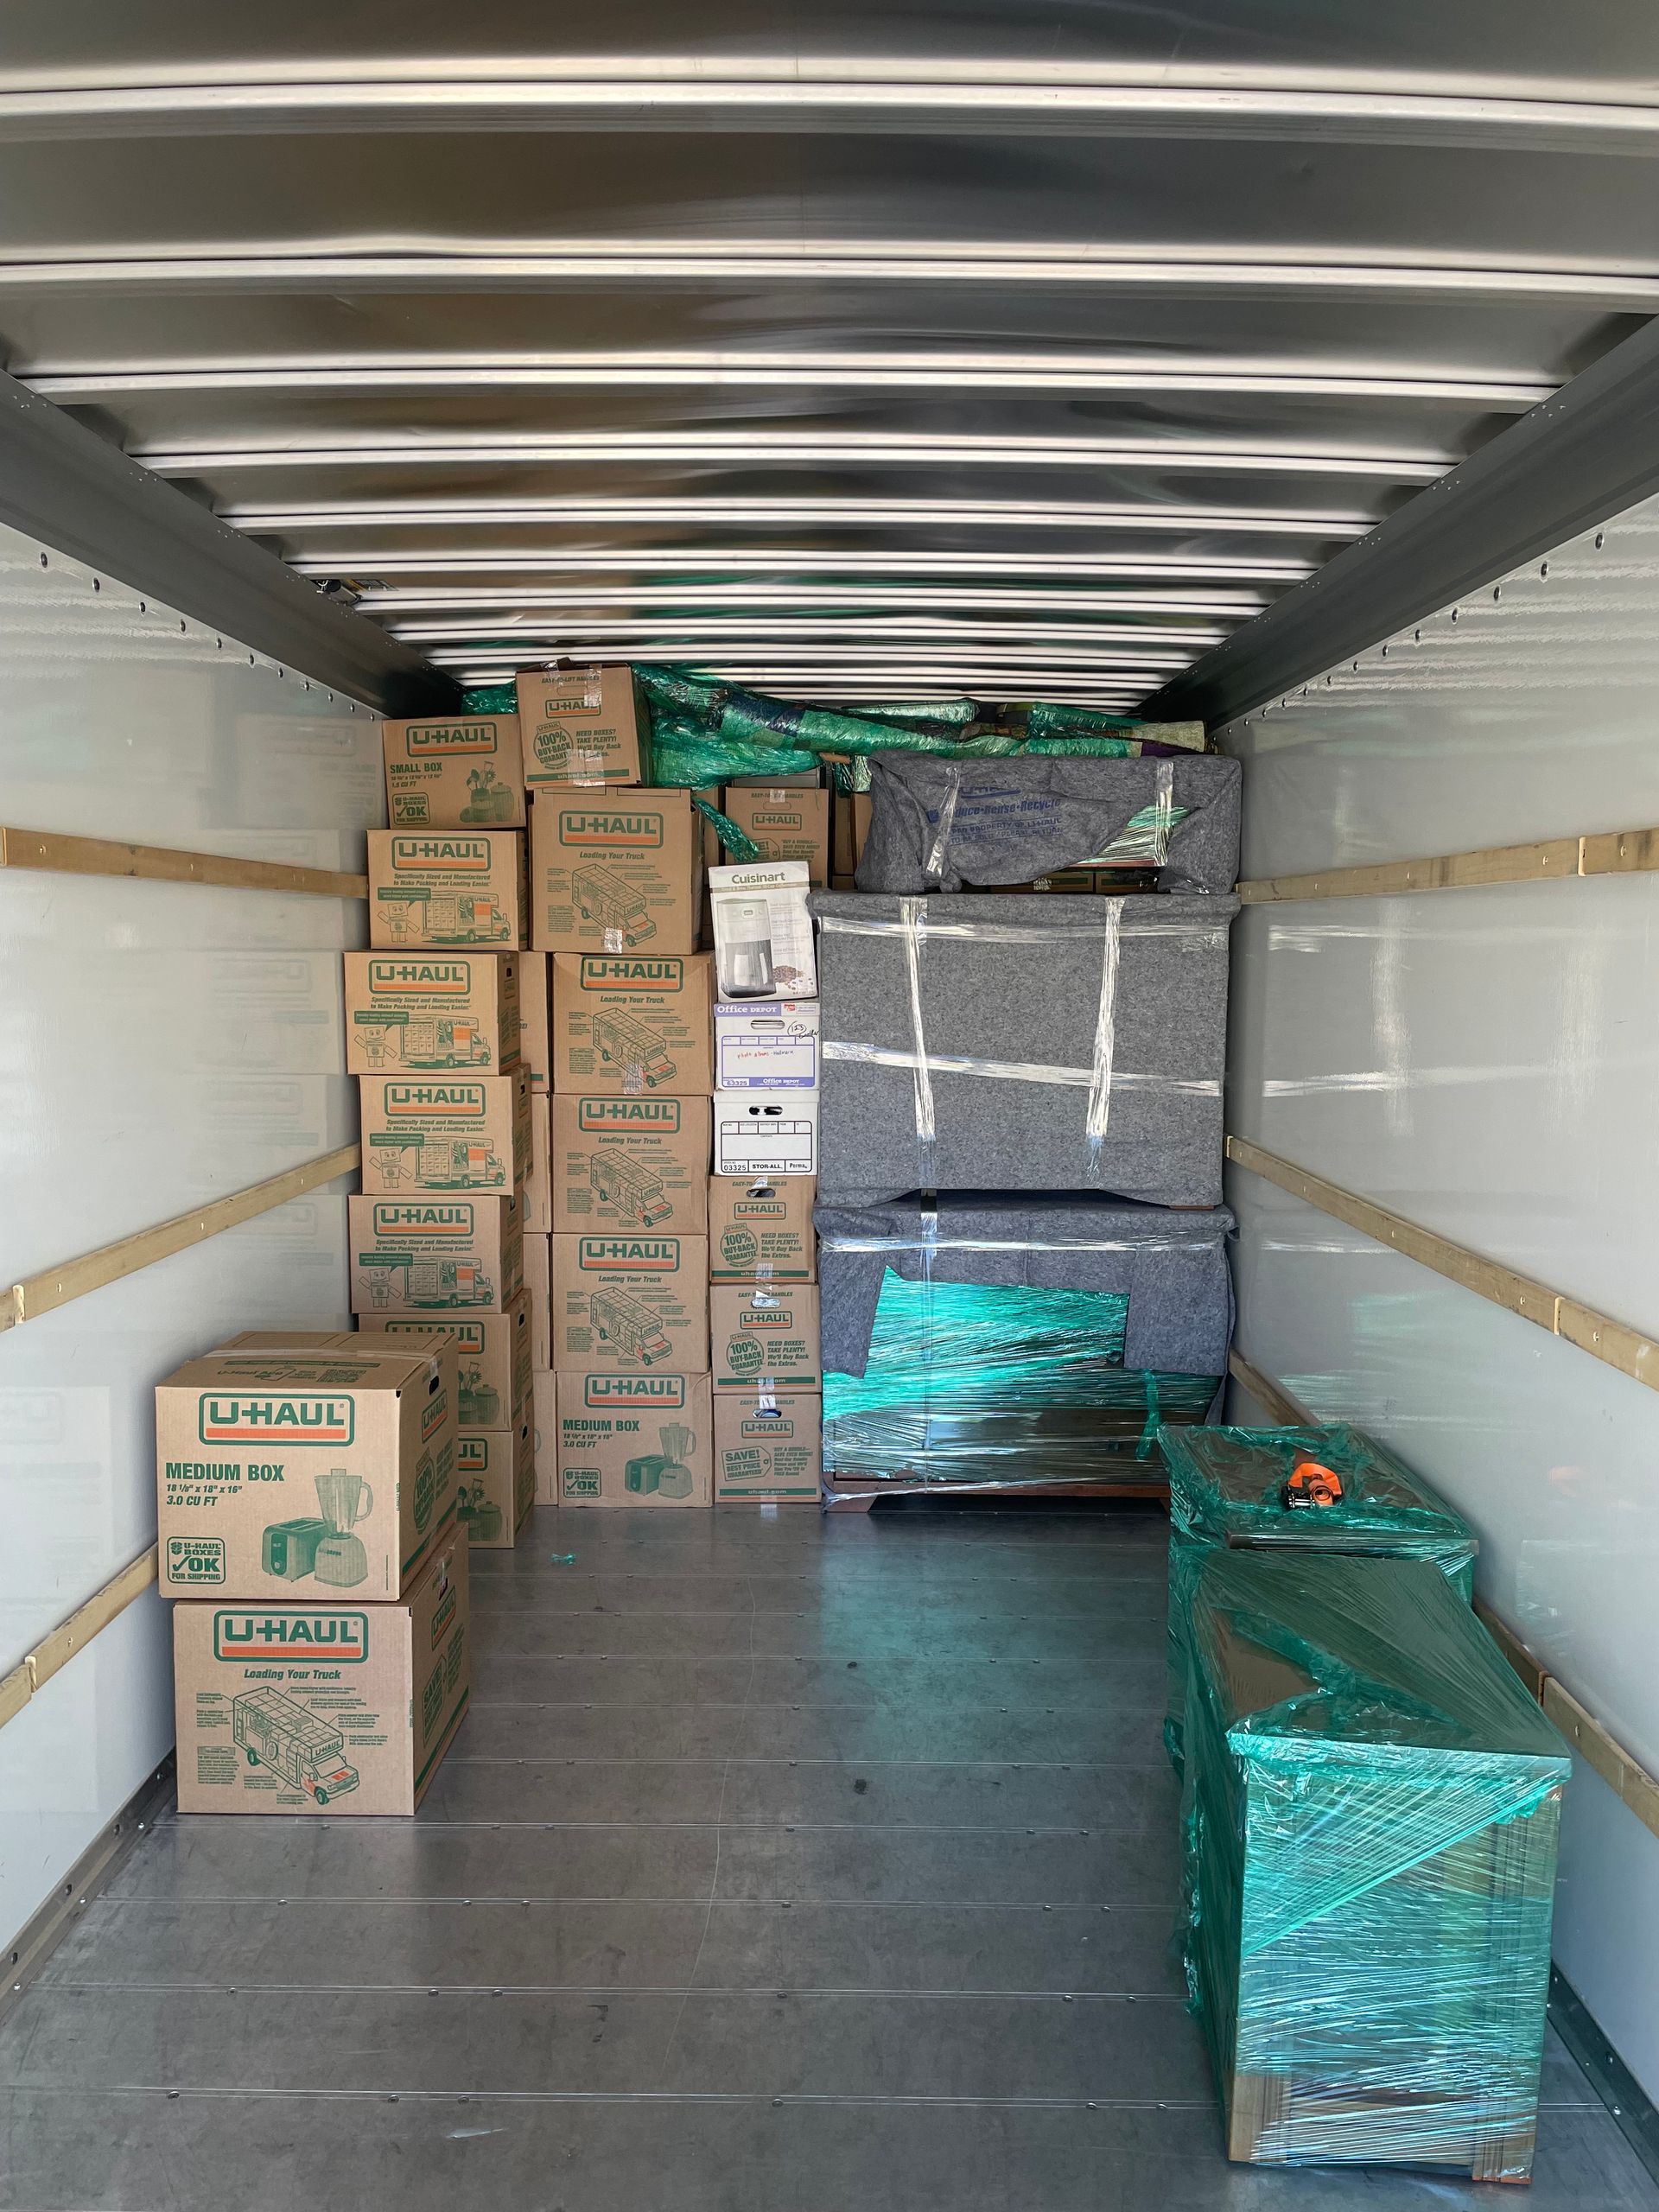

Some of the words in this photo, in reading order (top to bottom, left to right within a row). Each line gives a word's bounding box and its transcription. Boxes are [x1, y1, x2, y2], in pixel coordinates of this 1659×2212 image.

[412, 728, 492, 745] U-HAUL
[537, 731, 567, 747] 100%
[537, 742, 570, 757] BUY-BACK
[390, 763, 421, 774] SMALL
[423, 762, 442, 772] BOX
[405, 806, 427, 817] OK
[566, 817, 657, 835] U-HAUL
[755, 816, 799, 824] U-HAUL
[398, 842, 484, 858] U-HAUL
[579, 851, 607, 860] Loading
[731, 872, 785, 885] Cuisinart
[376, 965, 464, 982] U-HAUL
[588, 962, 677, 979] U-HAUL
[600, 995, 627, 1004] Loading
[716, 1005, 748, 1014] Office
[391, 1088, 479, 1103] U-HAUL
[586, 1103, 674, 1120] U-HAUL
[737, 1205, 783, 1213] U-HAUL
[380, 1209, 467, 1224] U-HAUL
[724, 1232, 752, 1246] 100%
[586, 1243, 673, 1259] U-HAUL
[723, 1243, 755, 1255] BUY-BACK
[743, 1313, 789, 1323] U-HAUL
[730, 1340, 759, 1355] 100%
[729, 1351, 762, 1363] BUY-BACK
[592, 1380, 678, 1395] U-HAUL
[209, 1402, 345, 1426] U-HAUL
[563, 1419, 612, 1432] MEDIUM
[615, 1420, 640, 1432] BOX
[745, 1423, 791, 1432] U-HAUL
[725, 1449, 760, 1462] SAVE!
[165, 1462, 241, 1481] MEDIUM
[247, 1464, 285, 1482] BOX
[576, 1481, 598, 1491] OK
[167, 1495, 183, 1505] 3.0
[187, 1496, 201, 1505] CU
[203, 1497, 218, 1507] FT
[188, 1557, 221, 1573] OK
[225, 1619, 359, 1643] U-HAUL
[244, 1668, 284, 1681] Loading
[287, 1669, 310, 1680] Your
[313, 1669, 342, 1680] Truck
